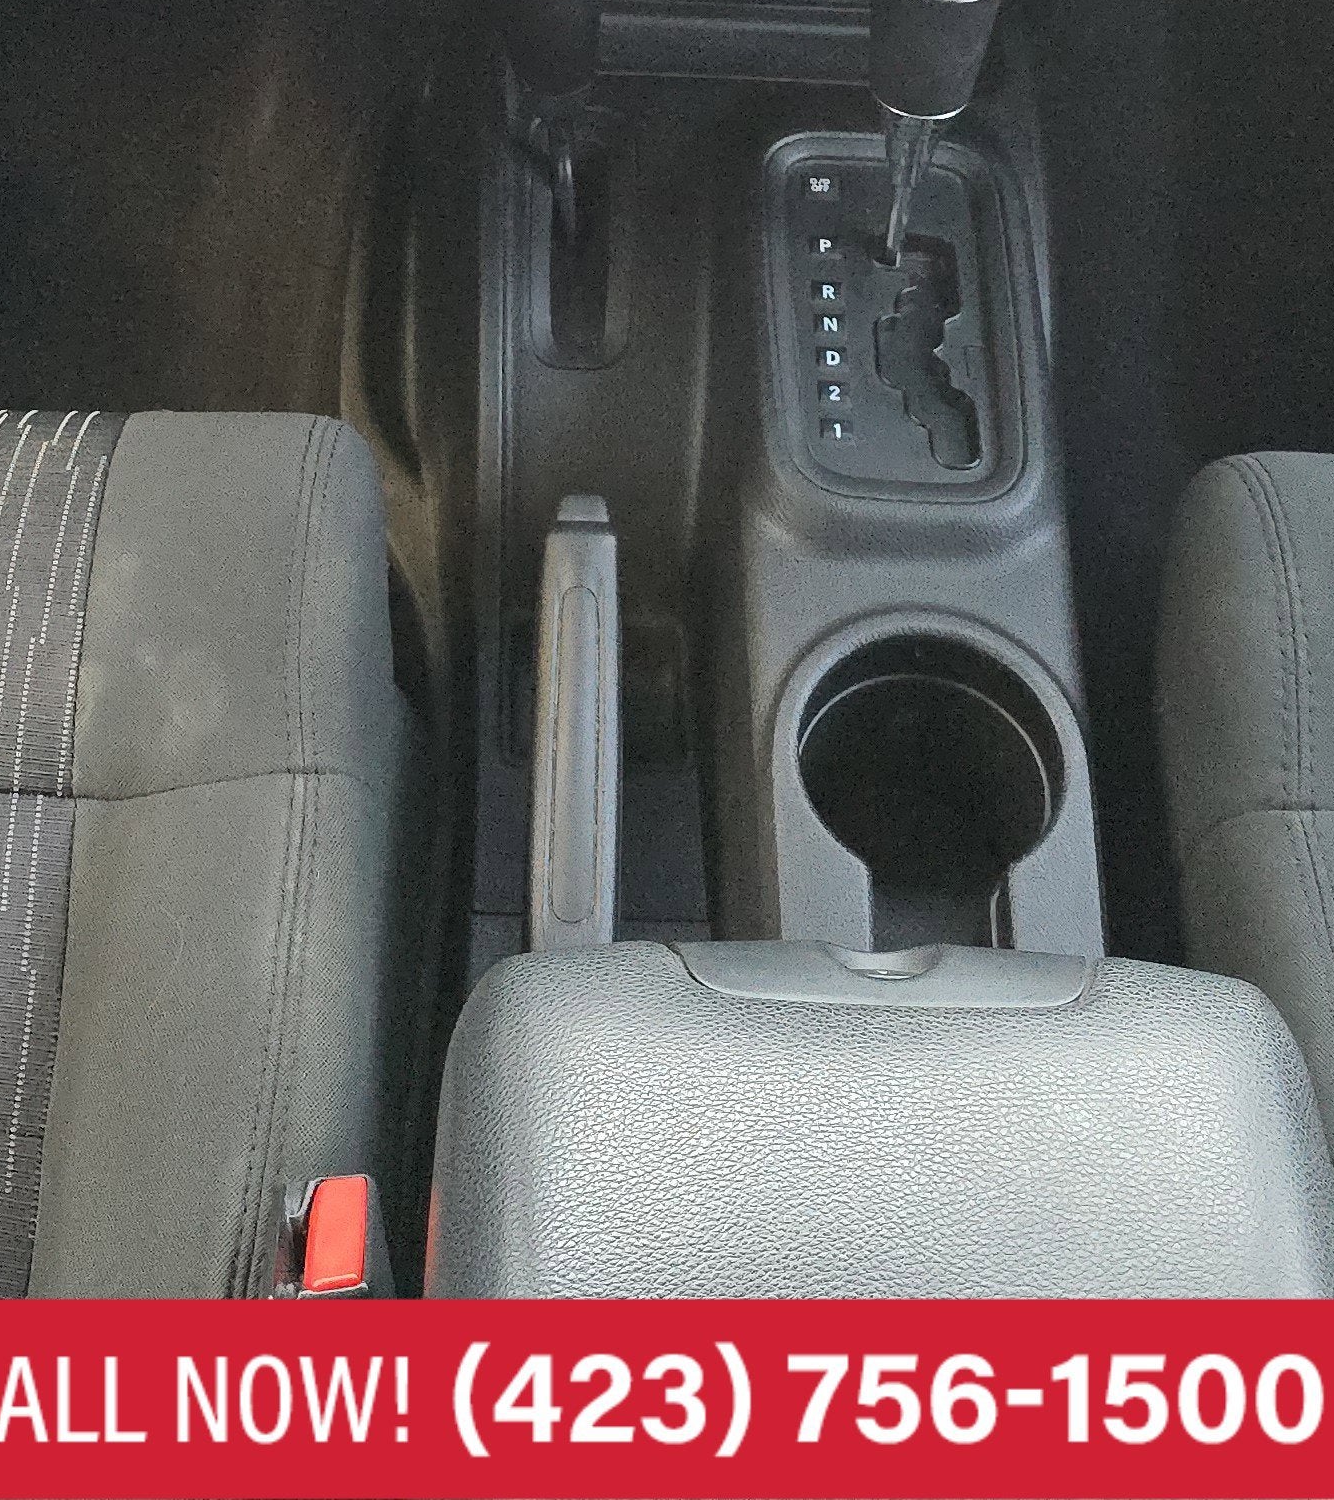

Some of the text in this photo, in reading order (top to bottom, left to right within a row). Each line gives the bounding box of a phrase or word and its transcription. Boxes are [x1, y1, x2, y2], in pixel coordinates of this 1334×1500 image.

[819, 238, 832, 253] P
[822, 284, 836, 300] R
[823, 316, 838, 332] N
[825, 350, 841, 366] D
[828, 385, 841, 401] 2
[833, 423, 842, 439] 1
